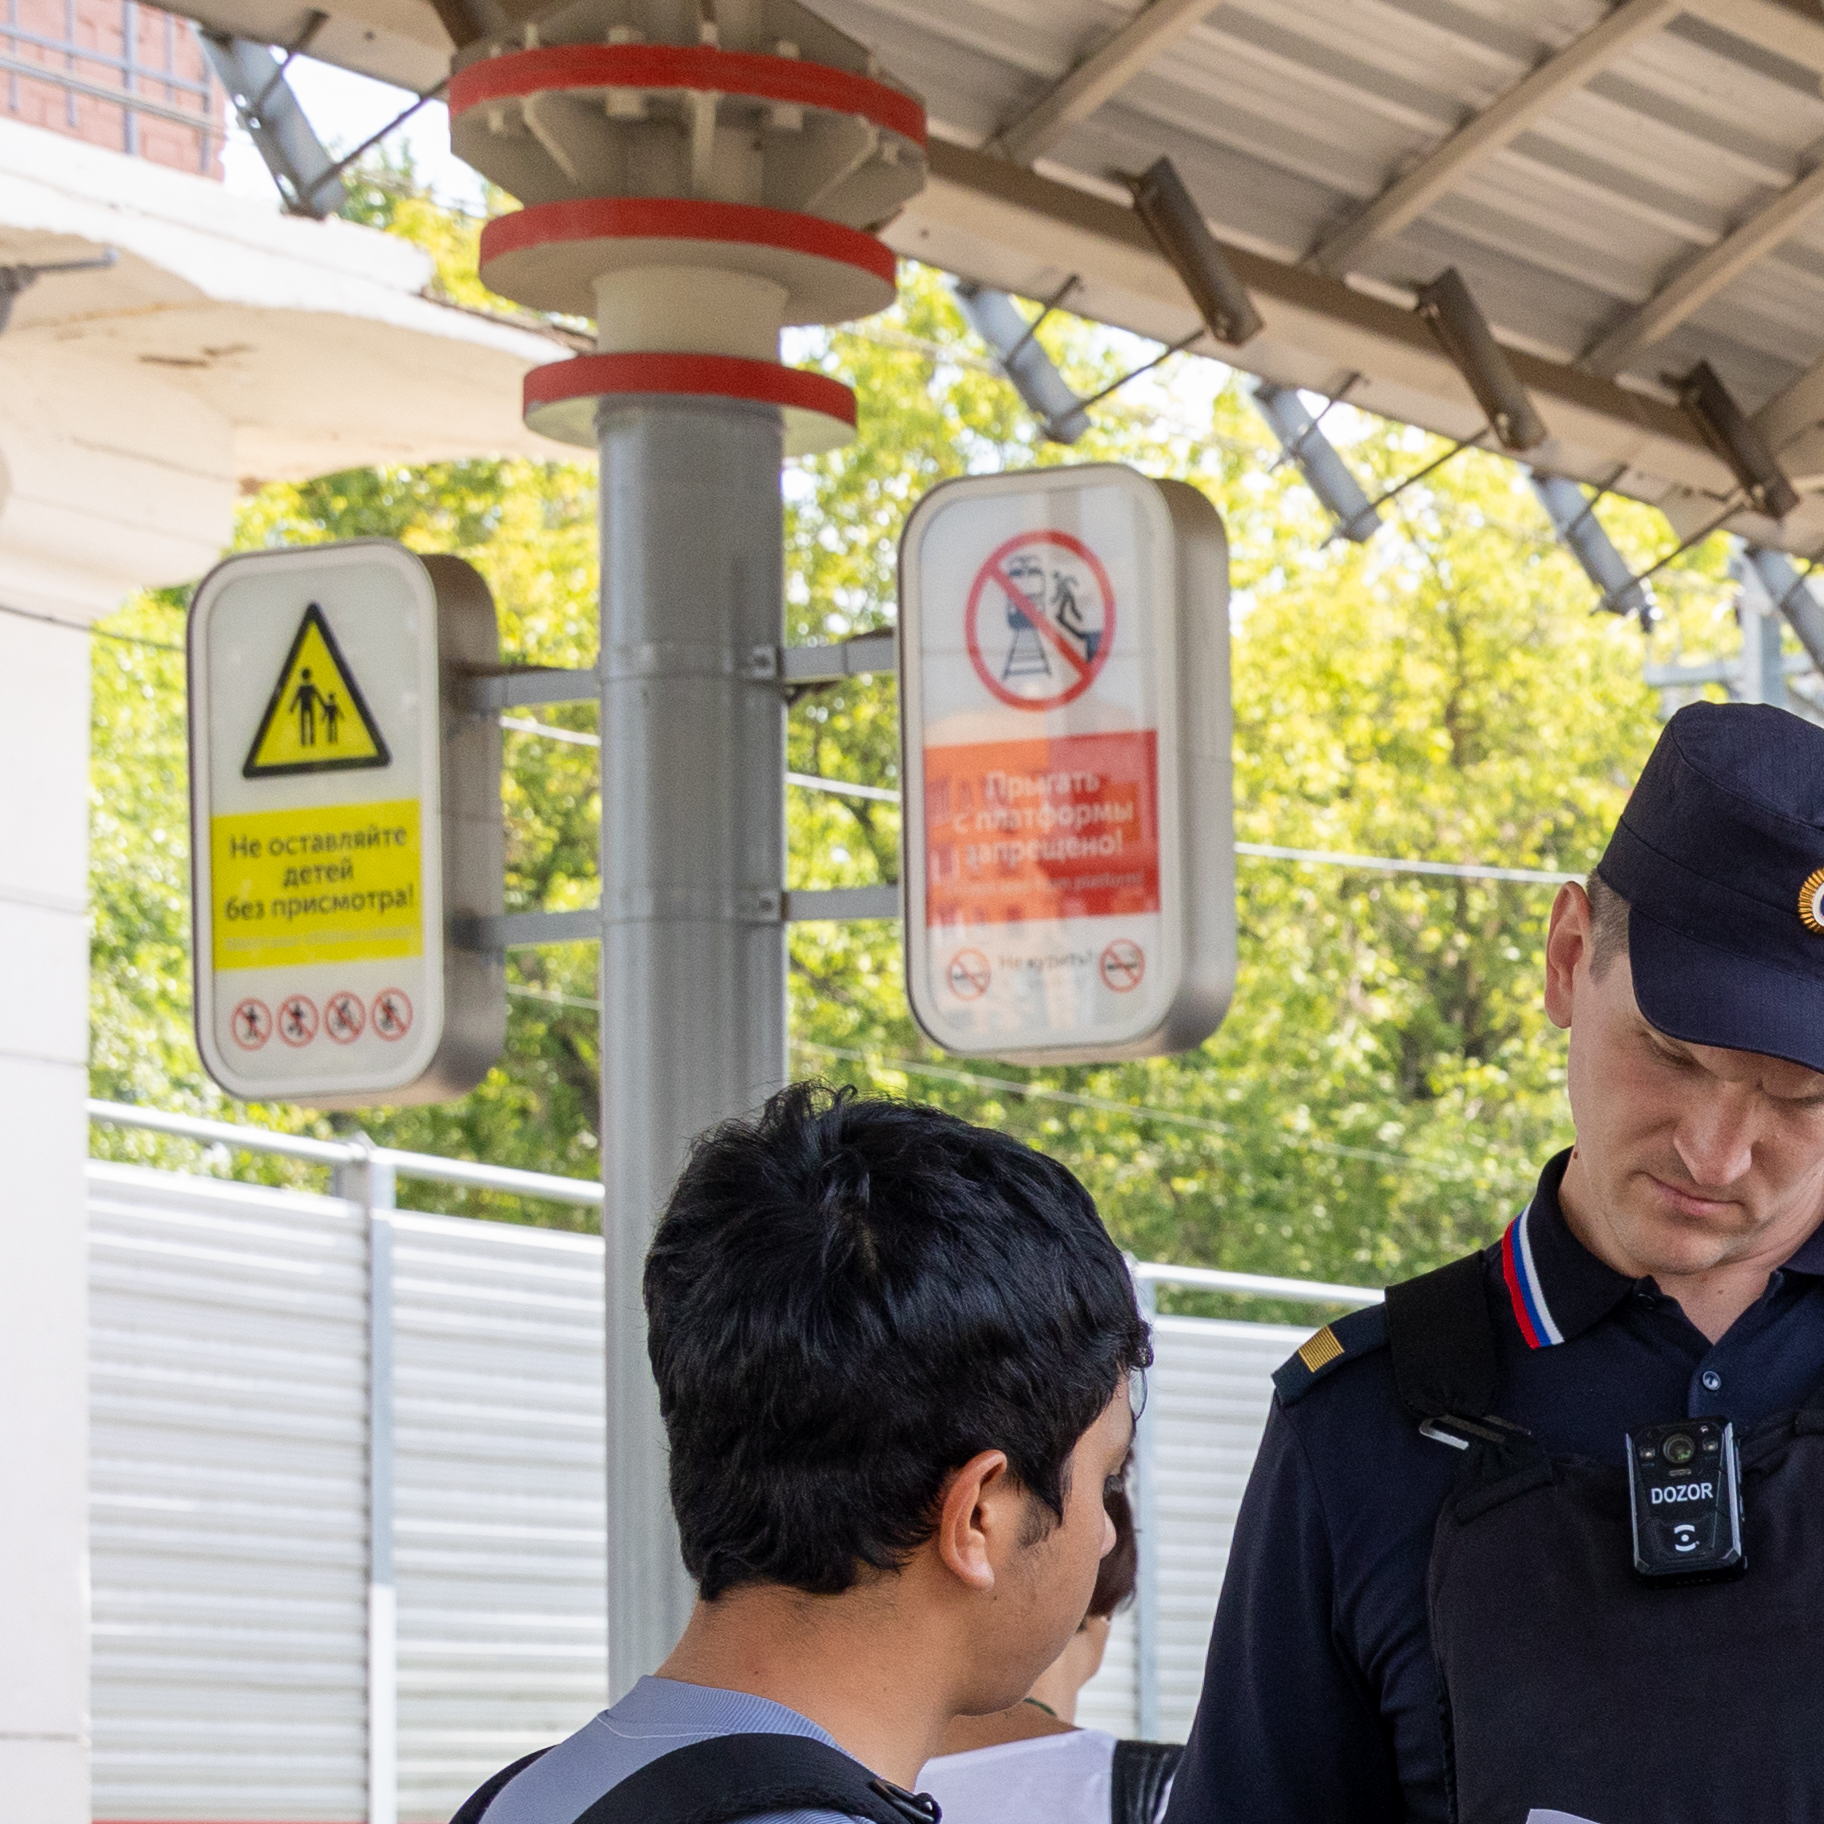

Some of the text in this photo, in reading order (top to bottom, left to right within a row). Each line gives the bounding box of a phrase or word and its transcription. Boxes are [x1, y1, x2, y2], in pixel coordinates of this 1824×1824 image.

[986, 770, 1099, 802] Прыгать
[953, 800, 1134, 834] с платформы
[229, 824, 407, 860] Не оставляйте
[283, 856, 353, 888] детей
[224, 883, 414, 923] без присмотра!
[1651, 1482, 1714, 1505] DOZOR
